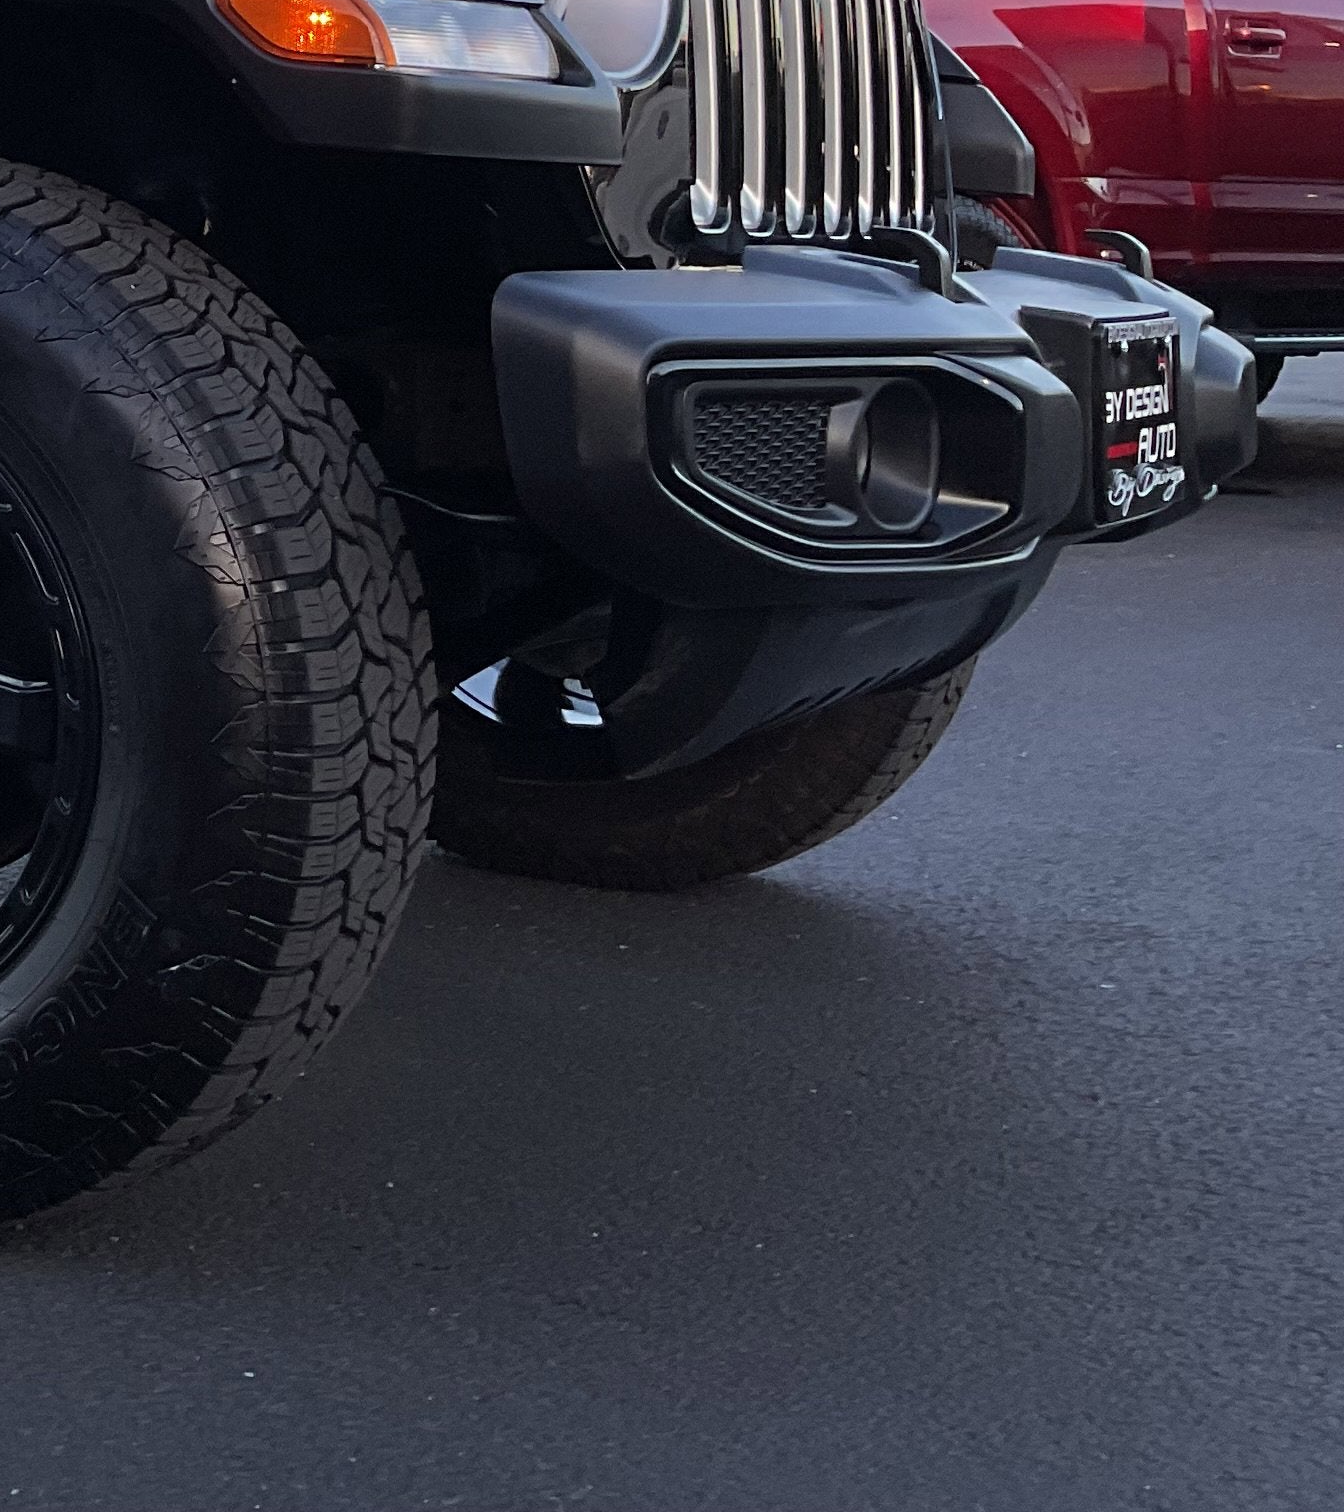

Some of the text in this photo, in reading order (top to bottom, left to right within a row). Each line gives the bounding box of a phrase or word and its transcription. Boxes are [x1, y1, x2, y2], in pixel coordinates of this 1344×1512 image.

[1105, 384, 1170, 424] BY DESIGN
[1138, 422, 1176, 465] AUTO
